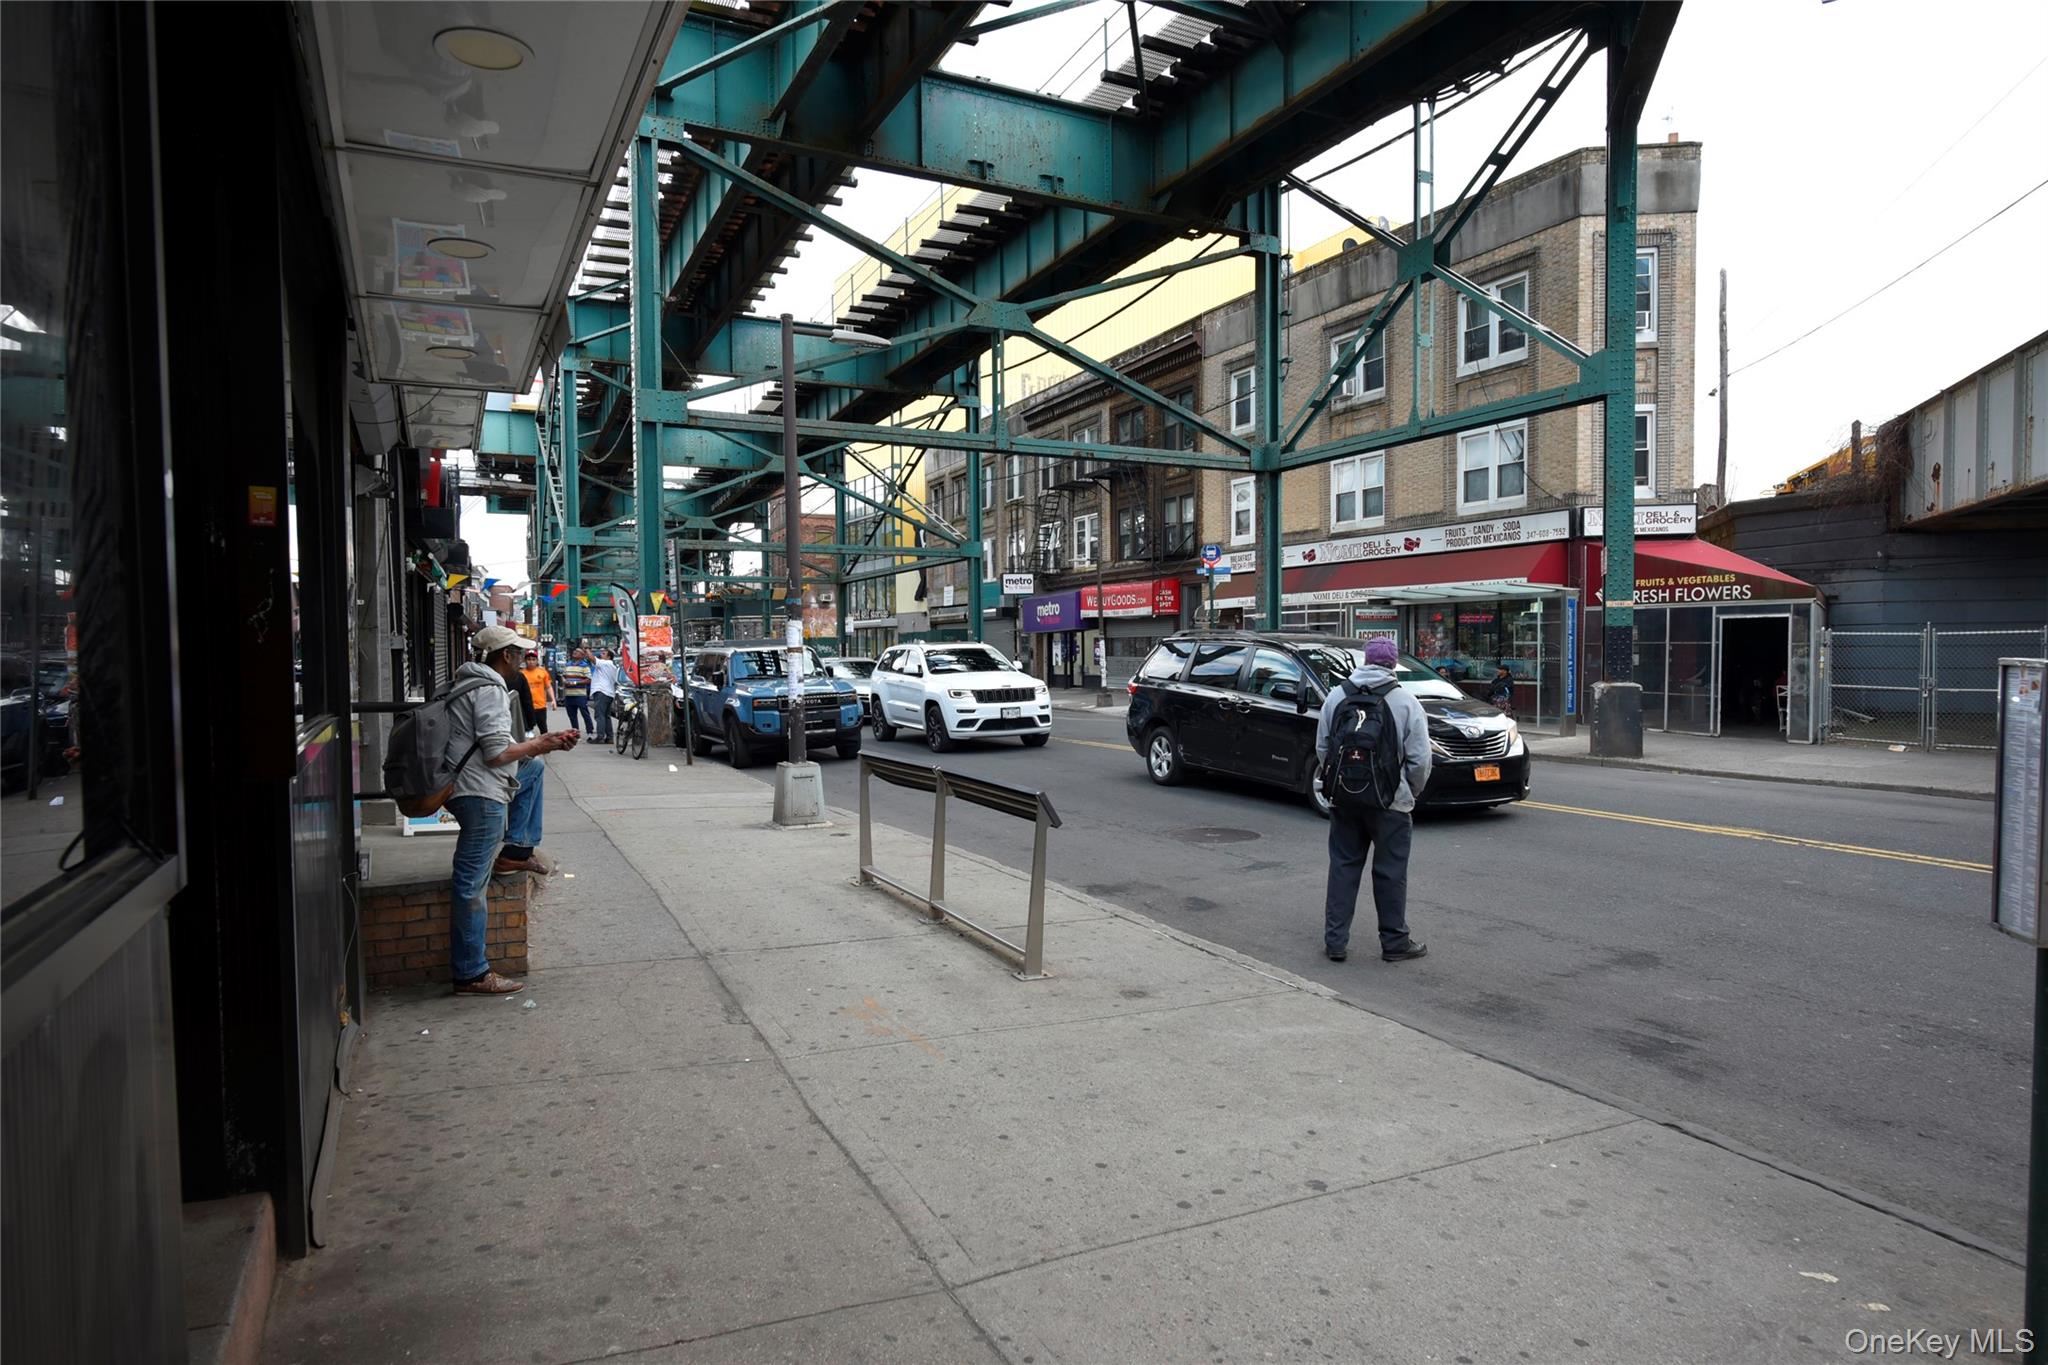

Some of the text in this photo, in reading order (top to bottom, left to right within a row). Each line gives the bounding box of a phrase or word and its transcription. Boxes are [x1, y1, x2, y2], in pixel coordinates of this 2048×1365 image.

[1645, 516, 1692, 524] GROCERY
[1445, 521, 1521, 538] FRUITS CANDY SODA
[1446, 531, 1521, 548] PRODUCTOS MEXICANOS
[1319, 539, 1391, 562] NOMI DELI &
[1363, 546, 1401, 557] GROCERY
[1005, 577, 1032, 585] metro
[1635, 574, 1736, 587] FRUITS & VEGETABLES
[1313, 592, 1331, 601] NOMI
[1633, 585, 1752, 604] RESH FLOWERS
[1037, 601, 1060, 617] metro
